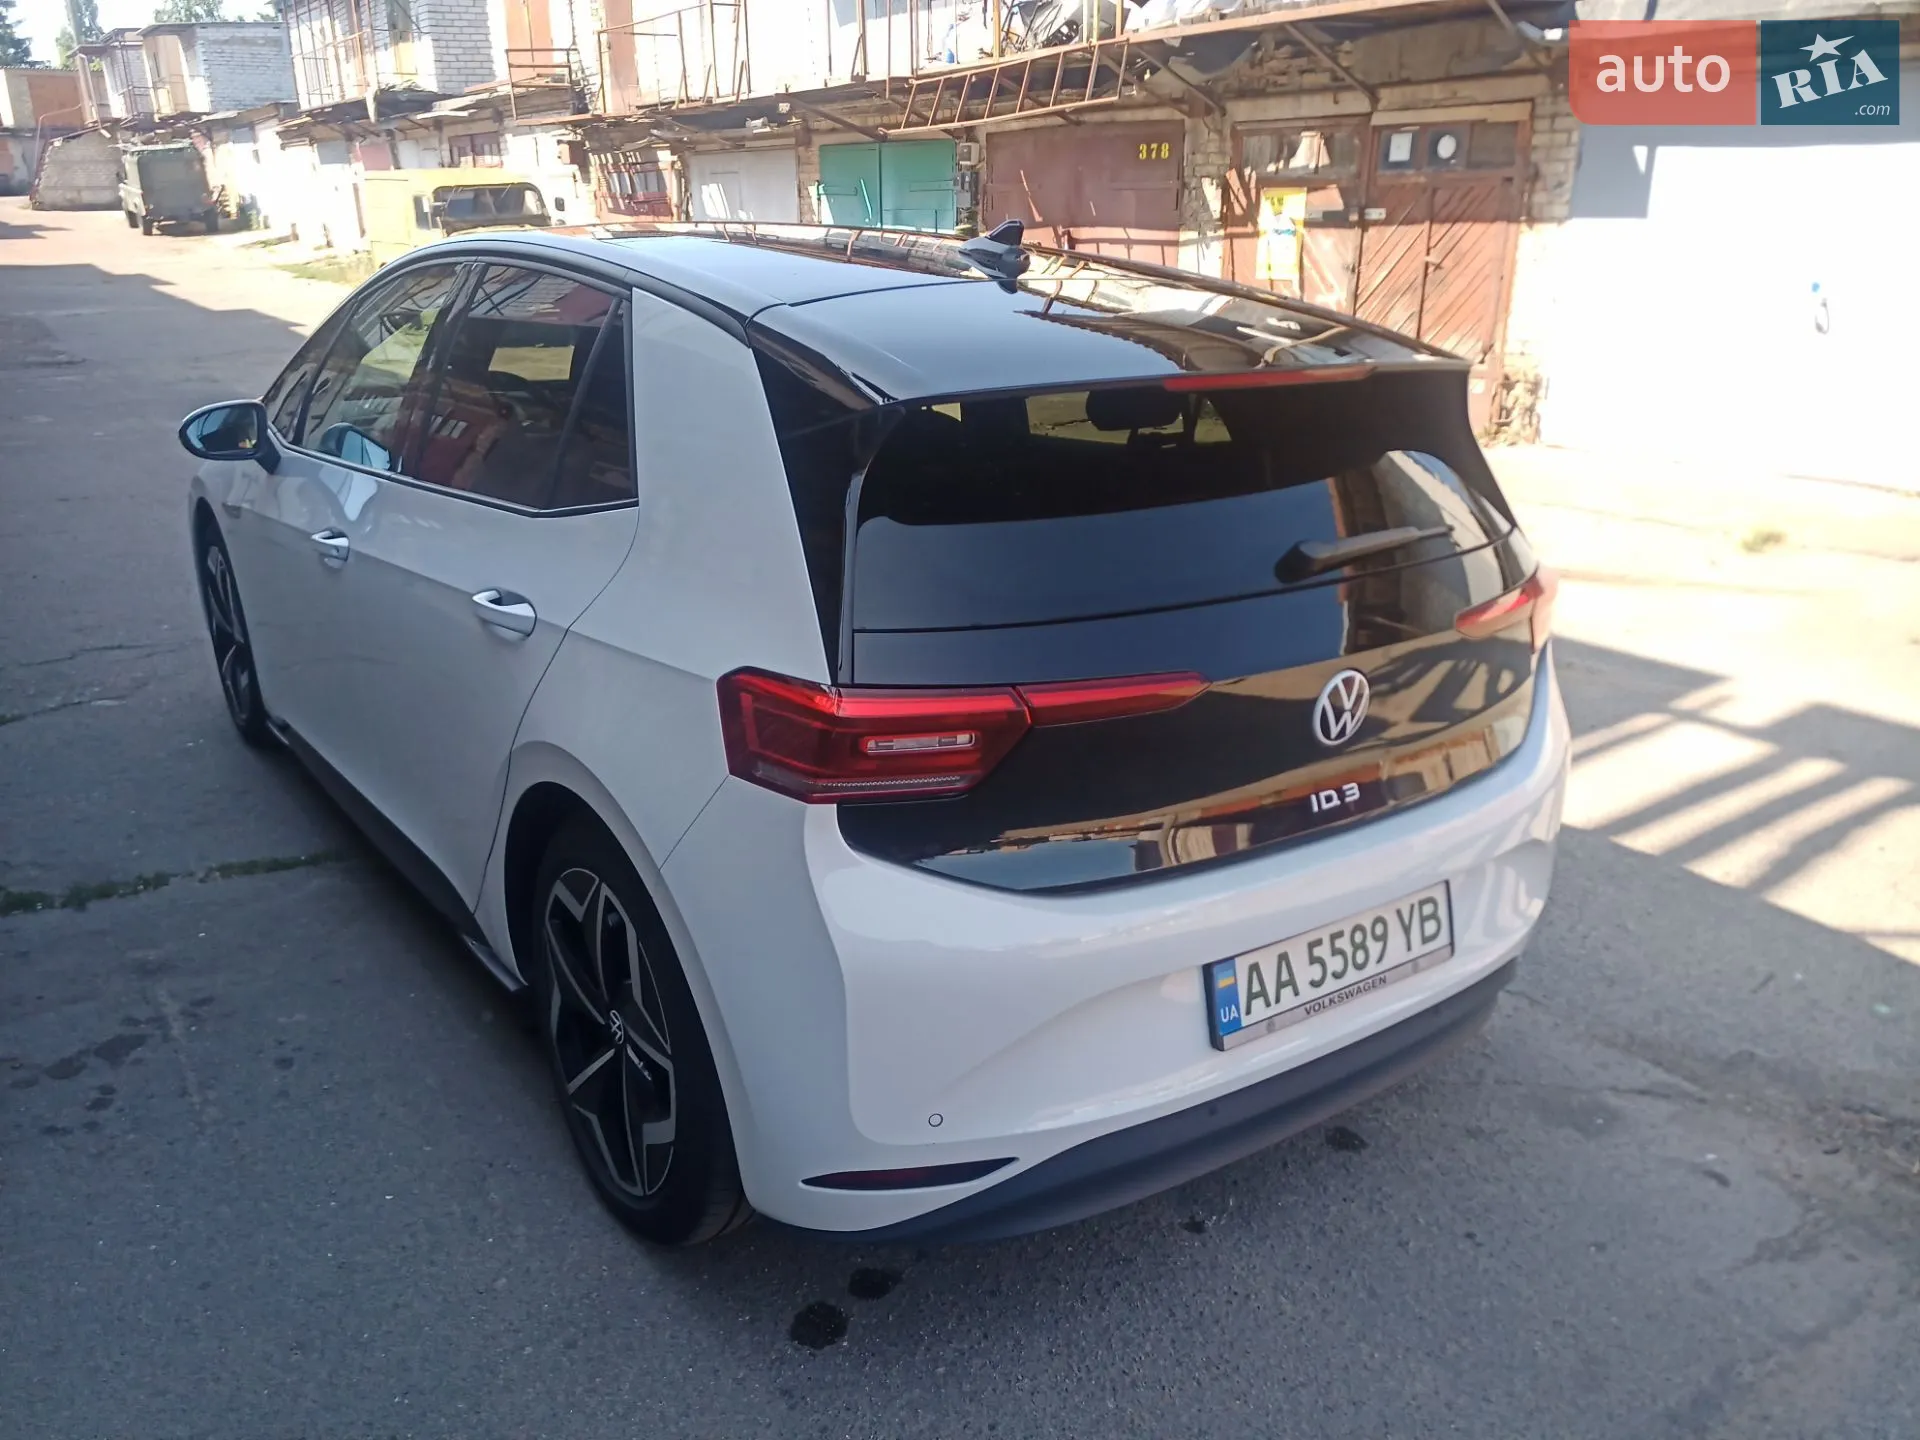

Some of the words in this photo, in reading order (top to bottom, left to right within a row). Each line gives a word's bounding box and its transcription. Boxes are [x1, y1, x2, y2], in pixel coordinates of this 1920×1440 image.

[1138, 142, 1170, 160] 378
[1244, 951, 1300, 1017] AA
[1306, 915, 1389, 989] 5589
[1395, 895, 1442, 952] YB
[1303, 974, 1388, 1016] VOLKSWAGEN
[1220, 1003, 1240, 1023] UA
